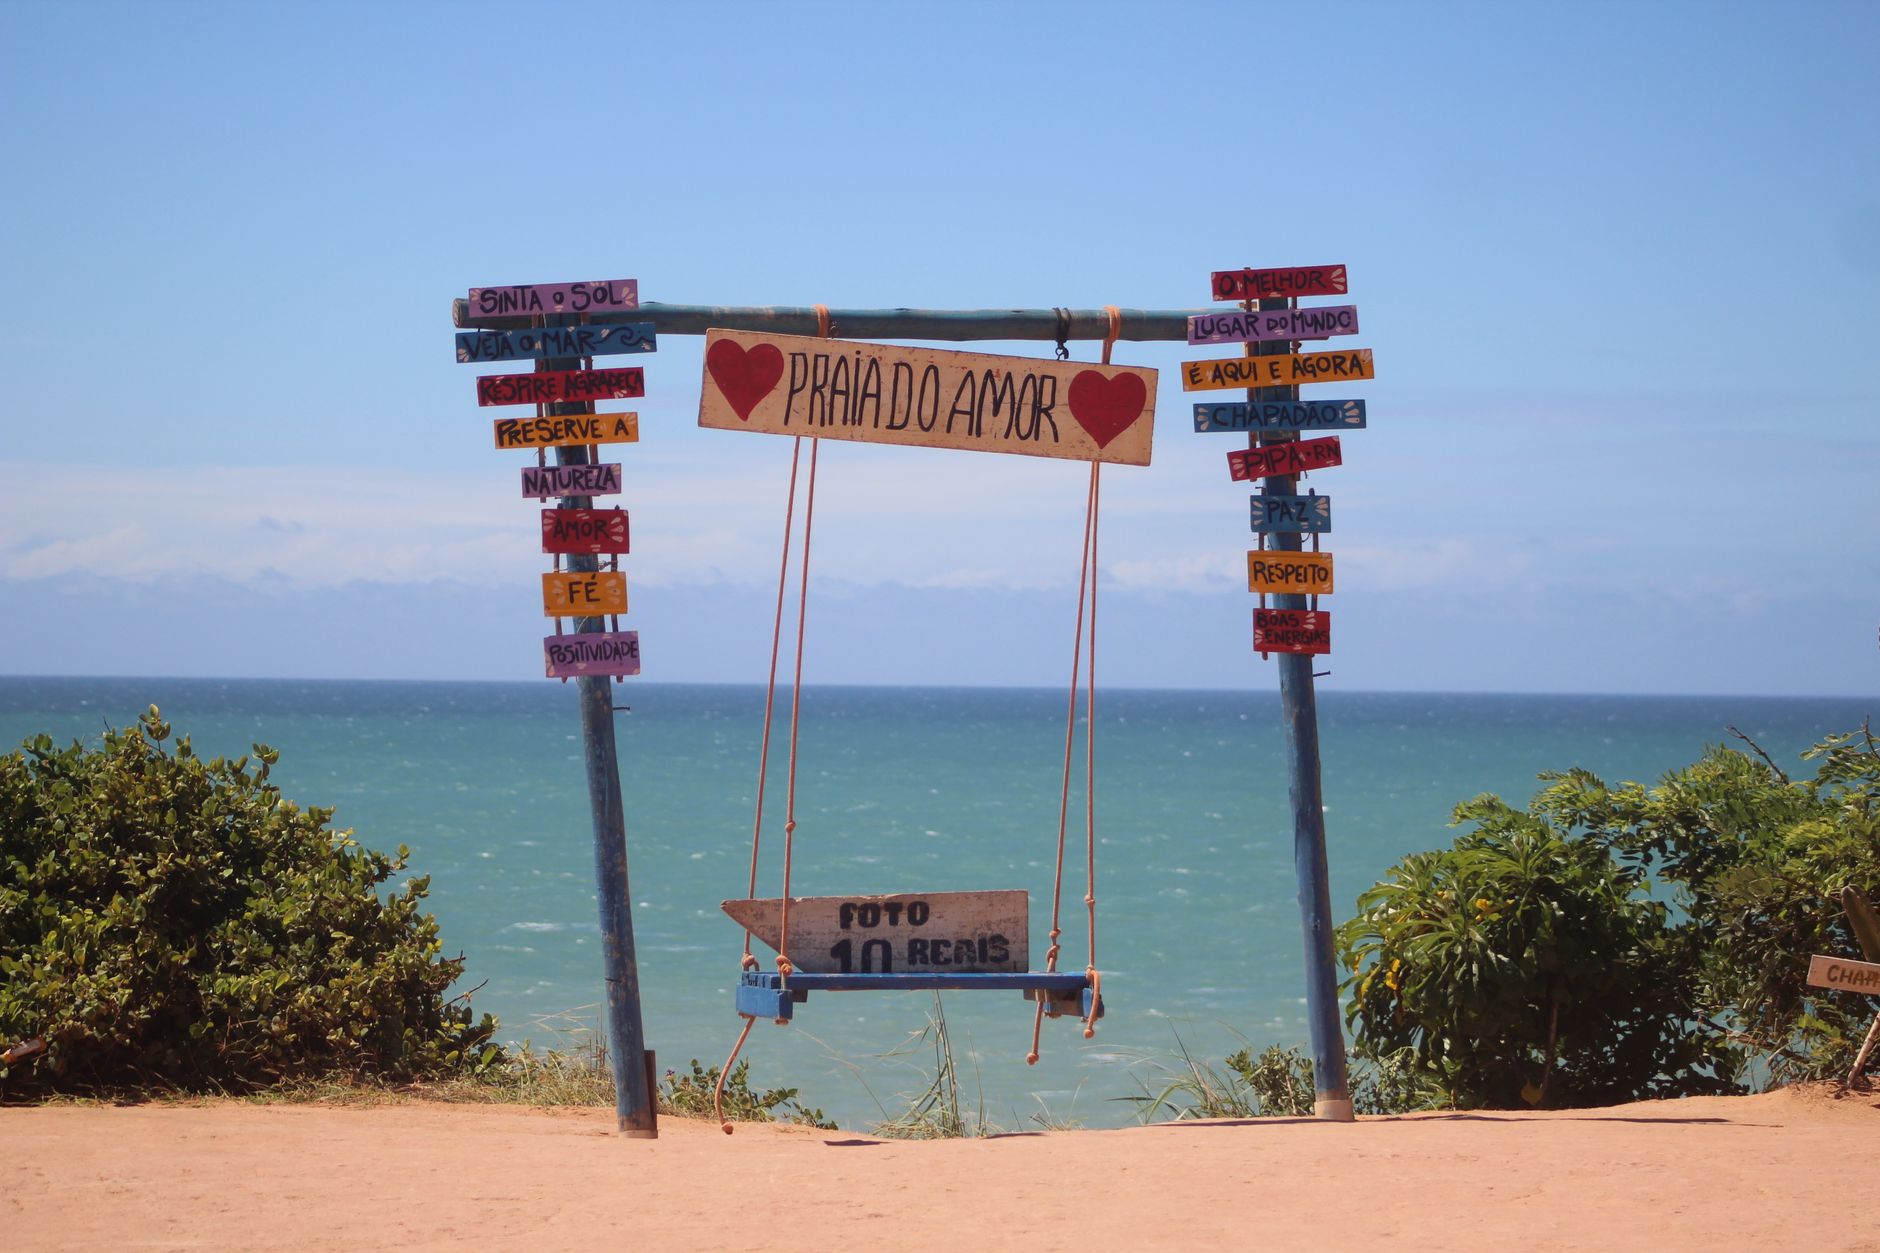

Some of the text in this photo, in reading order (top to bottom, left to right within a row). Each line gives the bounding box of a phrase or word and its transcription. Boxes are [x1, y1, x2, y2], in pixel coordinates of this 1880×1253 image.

[1218, 270, 1326, 295] O MELHOR
[479, 285, 543, 314] SINTA
[571, 281, 622, 311] SOL
[1194, 311, 1352, 340] LUGAR DO MUNDO
[462, 330, 596, 360] VEJA O MAR
[1189, 353, 1364, 386] É AQUI E AGORA
[479, 370, 644, 402] RESPIRE AGRADEÇA
[886, 361, 939, 432] DO
[946, 368, 1059, 442] AMOR
[496, 418, 629, 446] PRESERVE A
[523, 465, 617, 495] NATUREZA
[1266, 502, 1310, 524] PAZ
[552, 518, 610, 542] AMOR
[1253, 560, 1329, 584] RESPEITO
[568, 573, 601, 604] FÉ
[1257, 611, 1300, 628] BOAS
[1265, 629, 1330, 646] ENERGIAS
[549, 640, 638, 666] POSITIVIDADE
[839, 901, 930, 929] FOTO
[830, 933, 1010, 974] 10 REAIS
